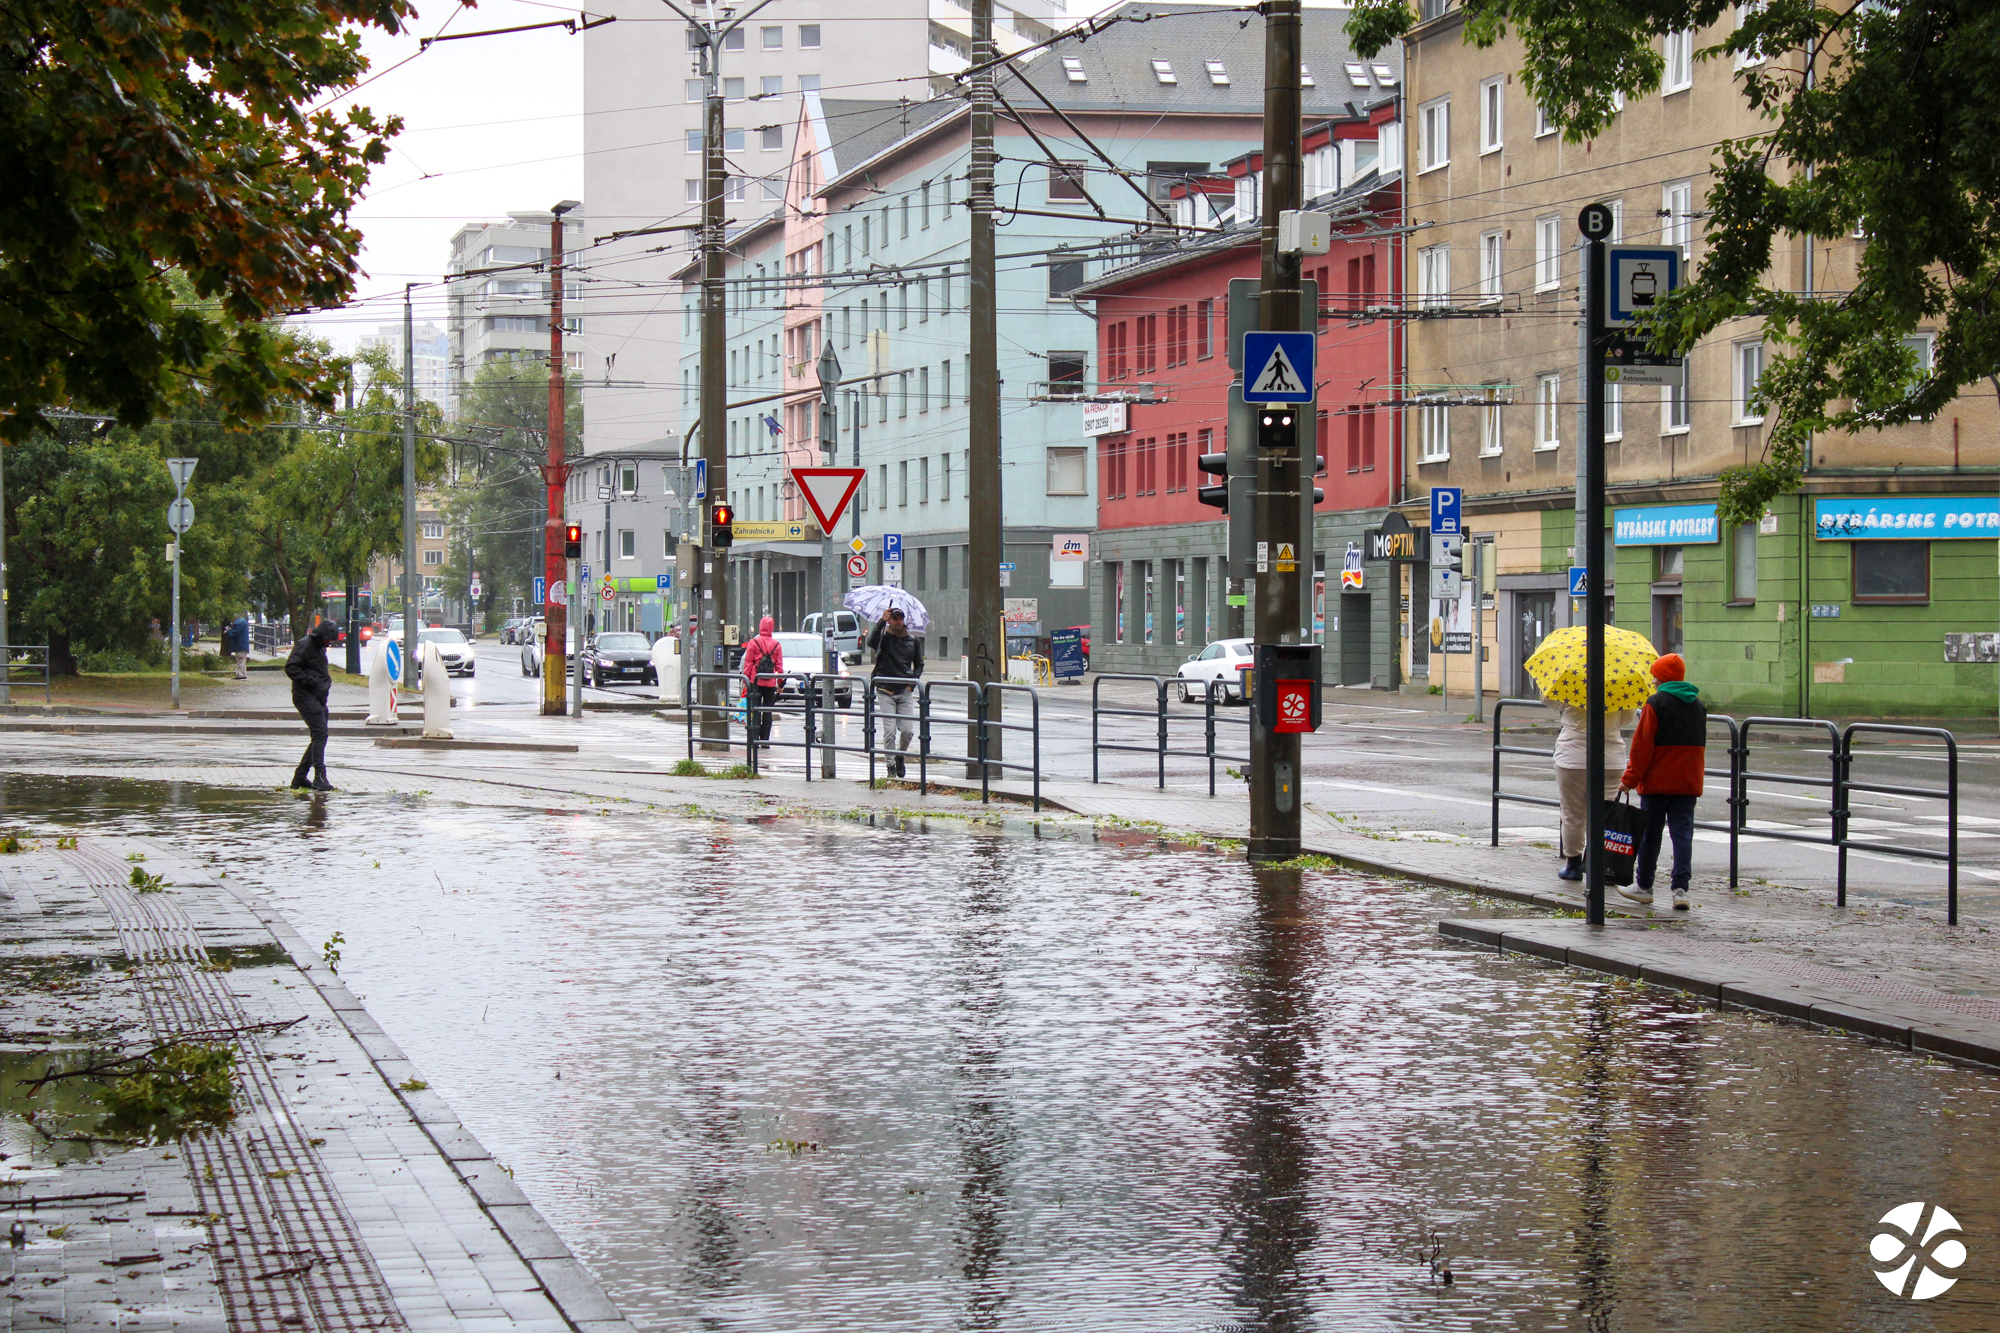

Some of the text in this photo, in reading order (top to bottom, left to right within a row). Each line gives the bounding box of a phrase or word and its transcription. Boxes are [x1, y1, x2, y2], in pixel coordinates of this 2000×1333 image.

[1588, 211, 1603, 233] B
[1609, 369, 1616, 379] 9
[1437, 491, 1454, 515] P
[1616, 514, 1715, 538] RYBÁRSKE POTREBY
[1820, 508, 1936, 528] RYBÁRSKE
[887, 536, 898, 550] P
[1063, 539, 1081, 550] dm
[1345, 543, 1360, 571] dm
[659, 576, 668, 587] P
[1604, 841, 1631, 854] IRECT
